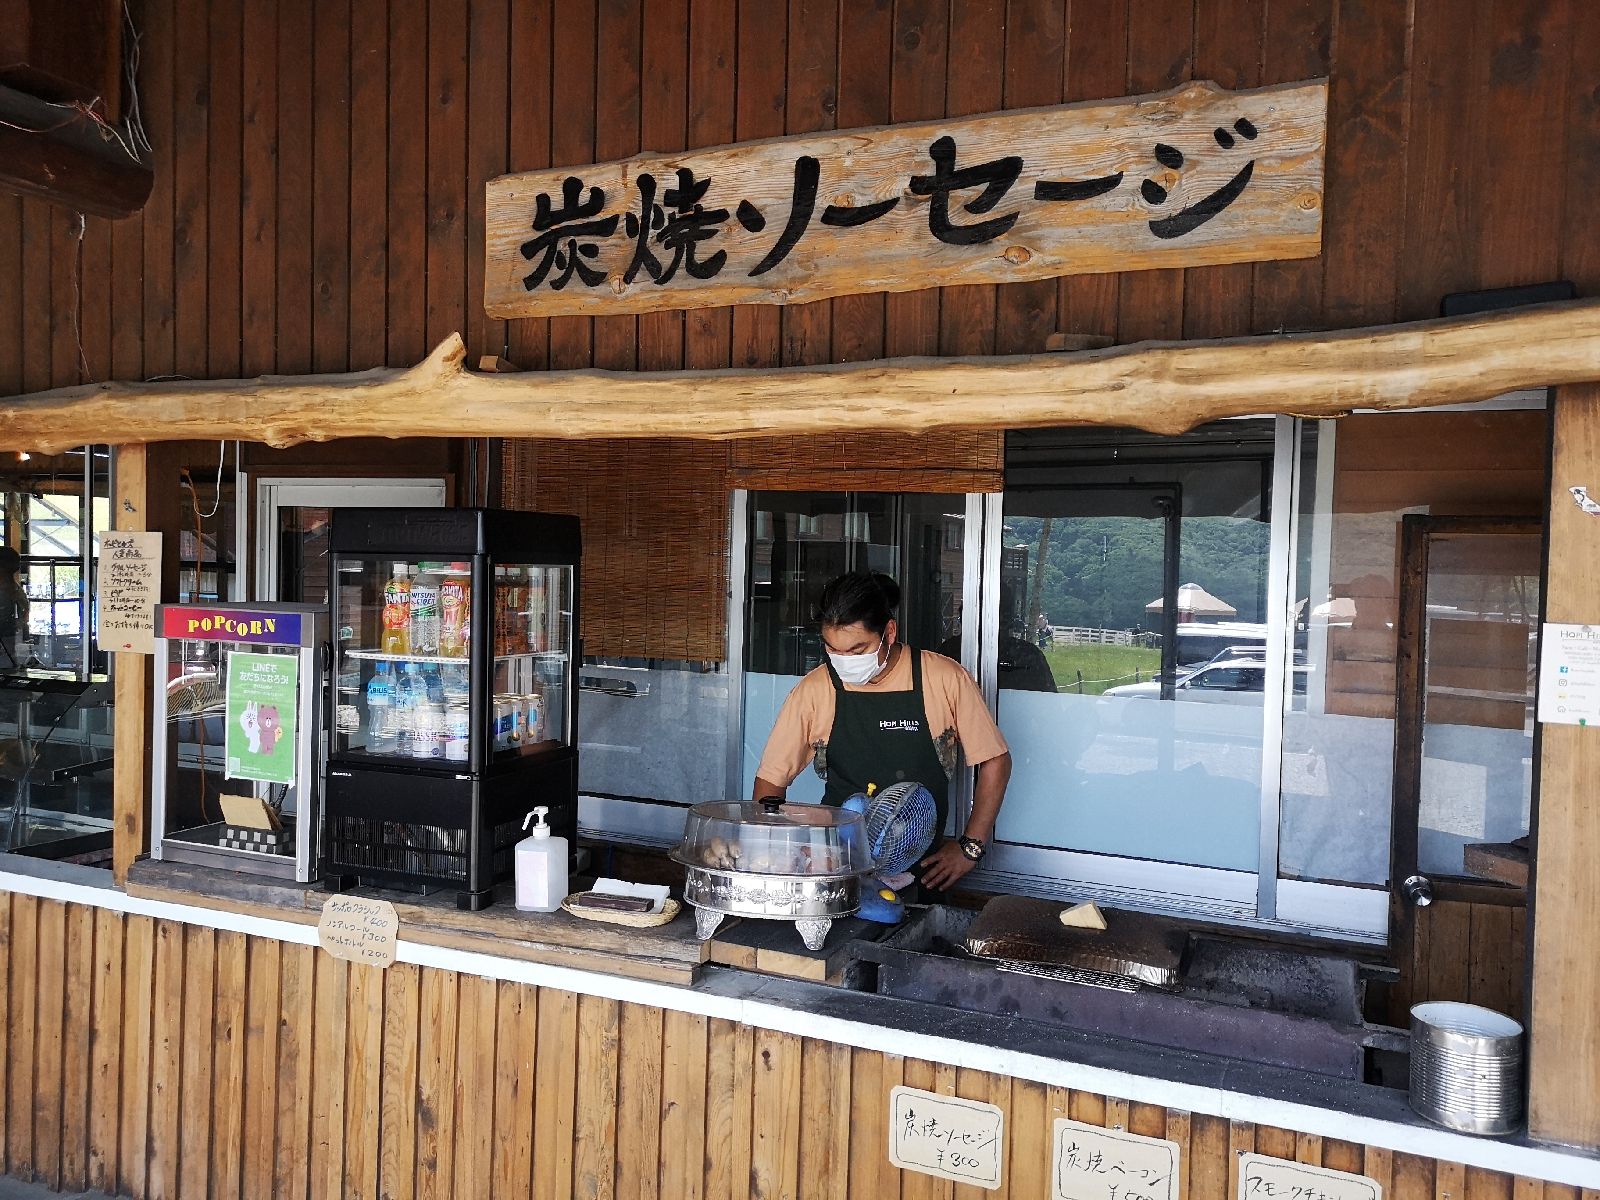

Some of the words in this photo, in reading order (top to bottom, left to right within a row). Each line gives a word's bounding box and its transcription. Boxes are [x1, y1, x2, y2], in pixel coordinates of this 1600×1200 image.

[521, 117, 1259, 291] 炭焼ソーセージ
[187, 615, 276, 637] POPCORN
[252, 663, 277, 673] LINEで
[903, 1108, 1000, 1150] 炭焼ソーセージ
[1066, 1142, 1176, 1187] 炭焼ベーコン
